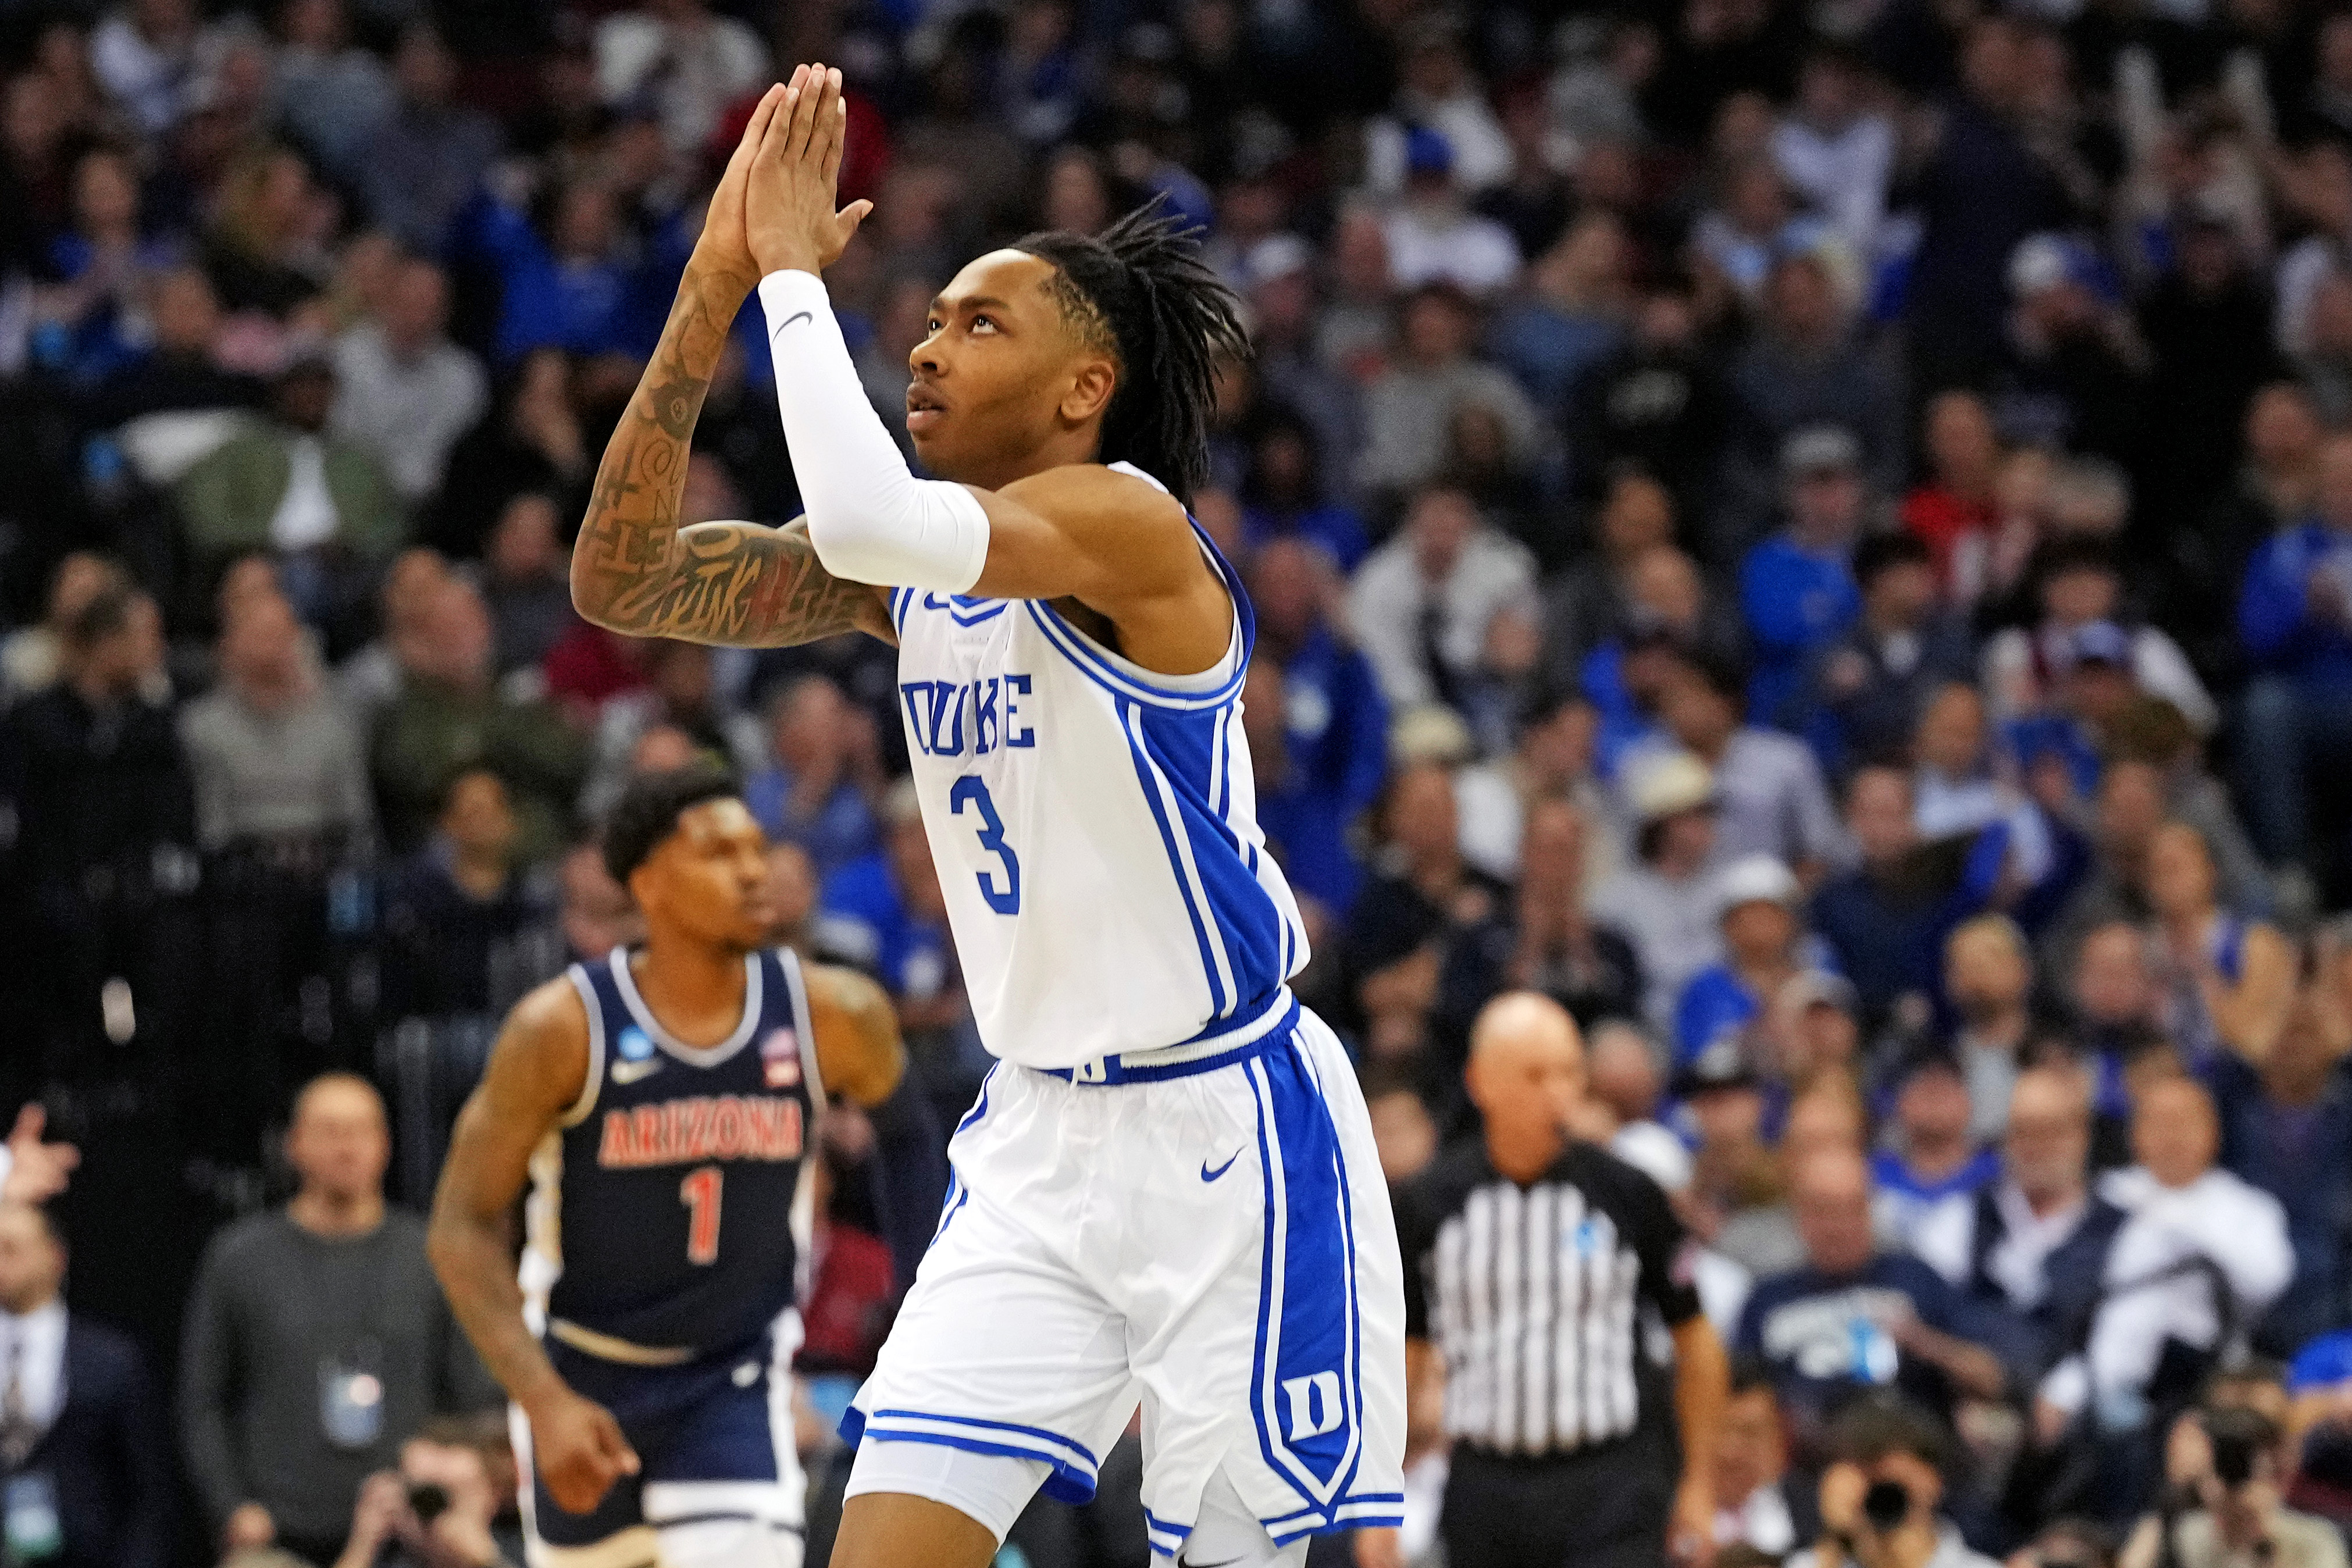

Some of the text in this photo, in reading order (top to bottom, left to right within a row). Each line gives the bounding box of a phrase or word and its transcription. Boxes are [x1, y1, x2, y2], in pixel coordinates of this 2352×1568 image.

[900, 673, 1035, 757] DUKE
[950, 775, 1020, 915] 3
[598, 1094, 804, 1170] ARIZONA
[679, 1166, 724, 1266] 1
[1281, 1370, 1343, 1442] D
